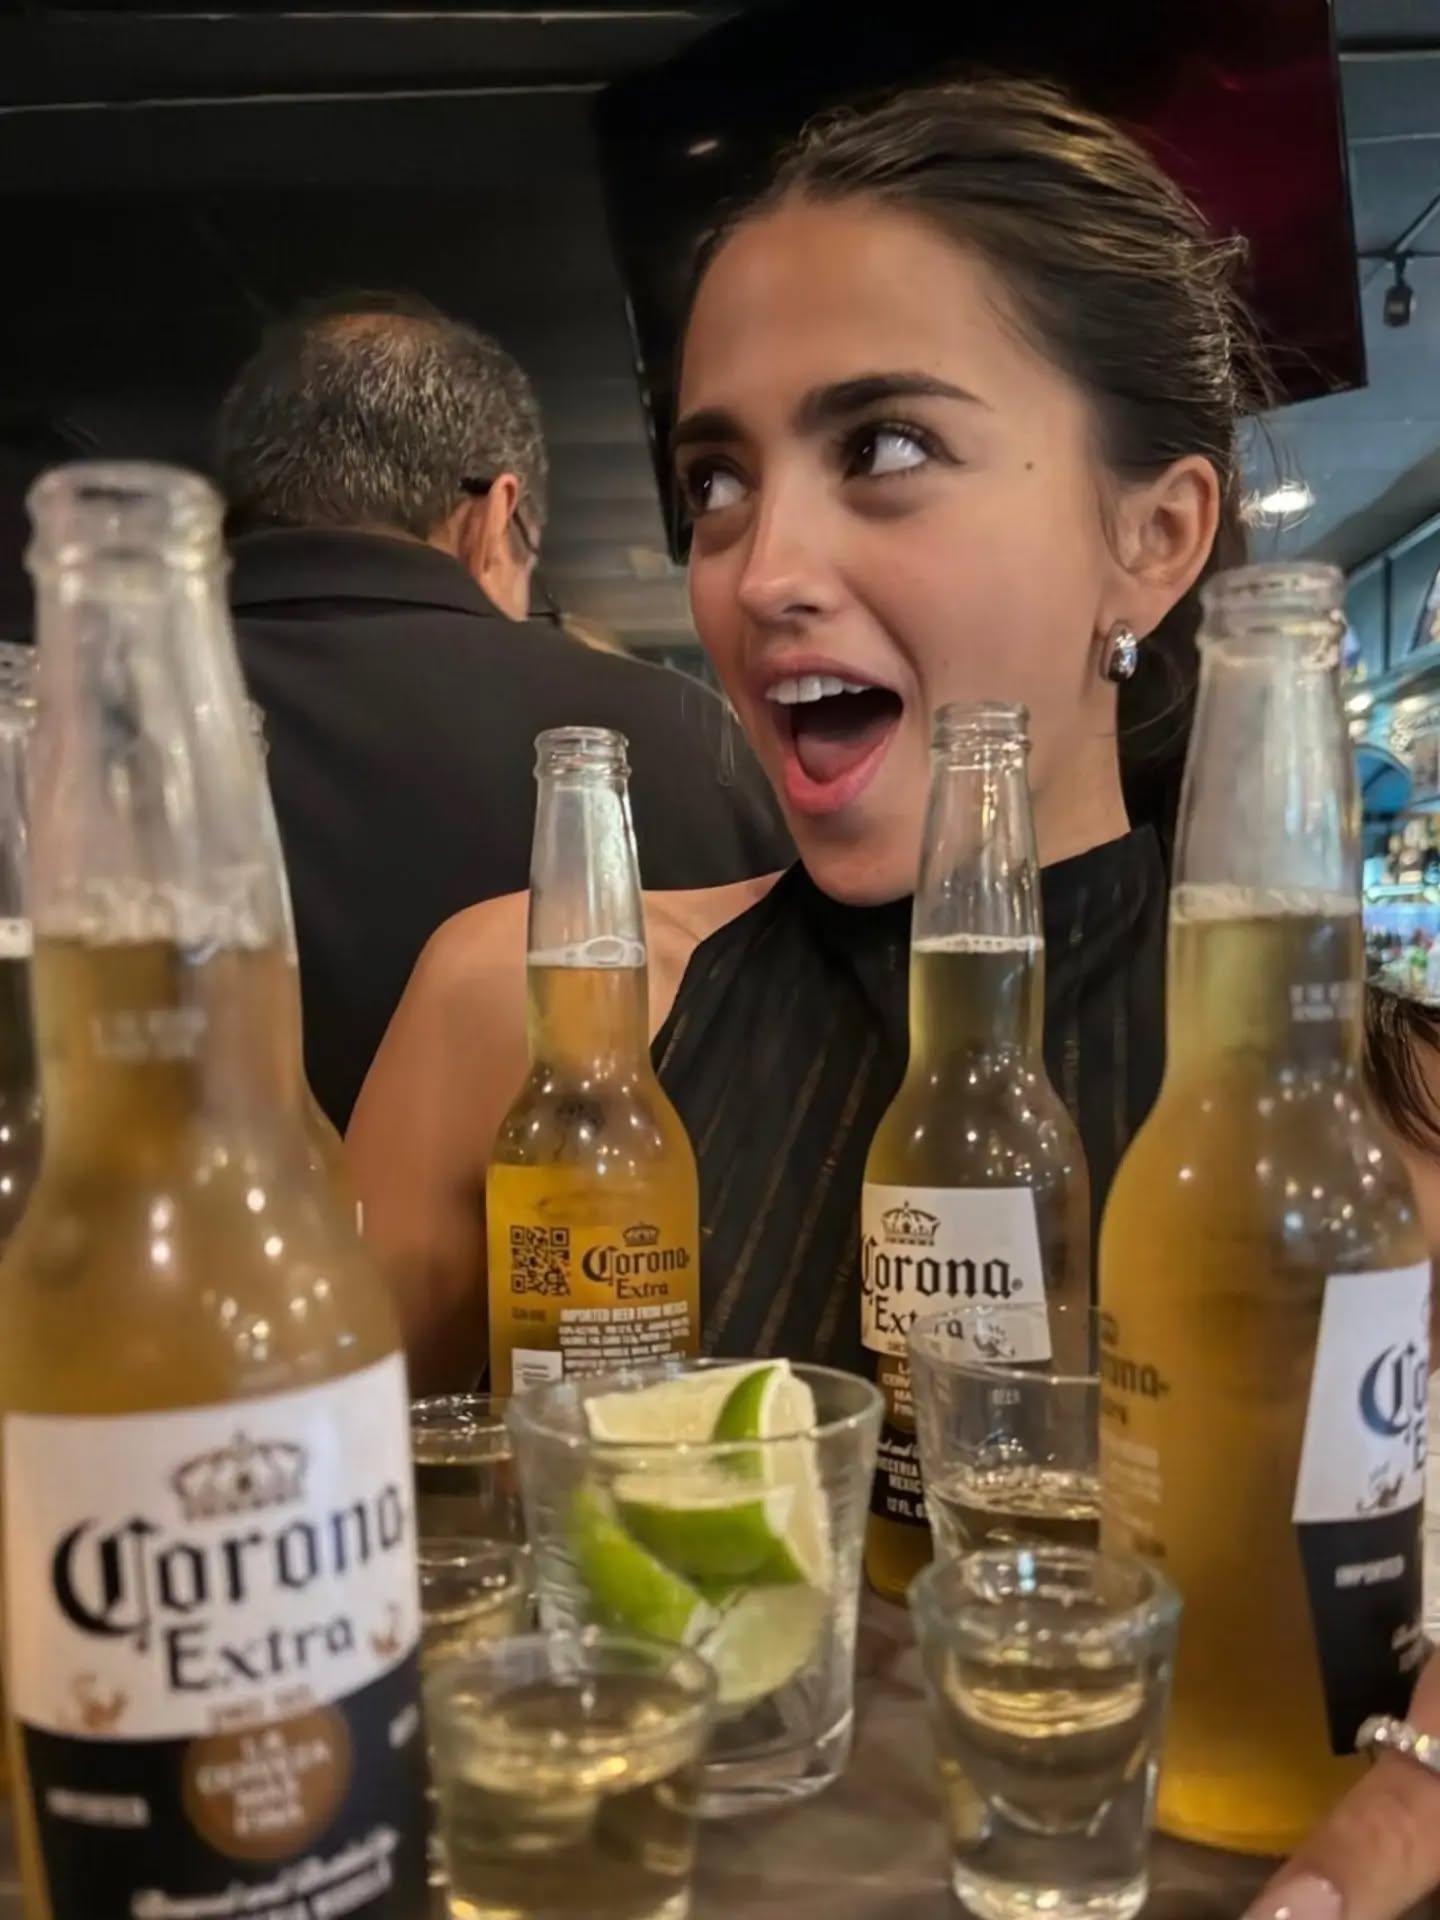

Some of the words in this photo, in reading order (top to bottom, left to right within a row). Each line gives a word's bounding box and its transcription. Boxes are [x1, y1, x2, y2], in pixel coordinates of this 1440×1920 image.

[582, 1246, 688, 1286] Corona
[616, 1278, 668, 1300] Extra
[51, 1485, 405, 1653] Corona
[164, 1613, 356, 1695] Extra
